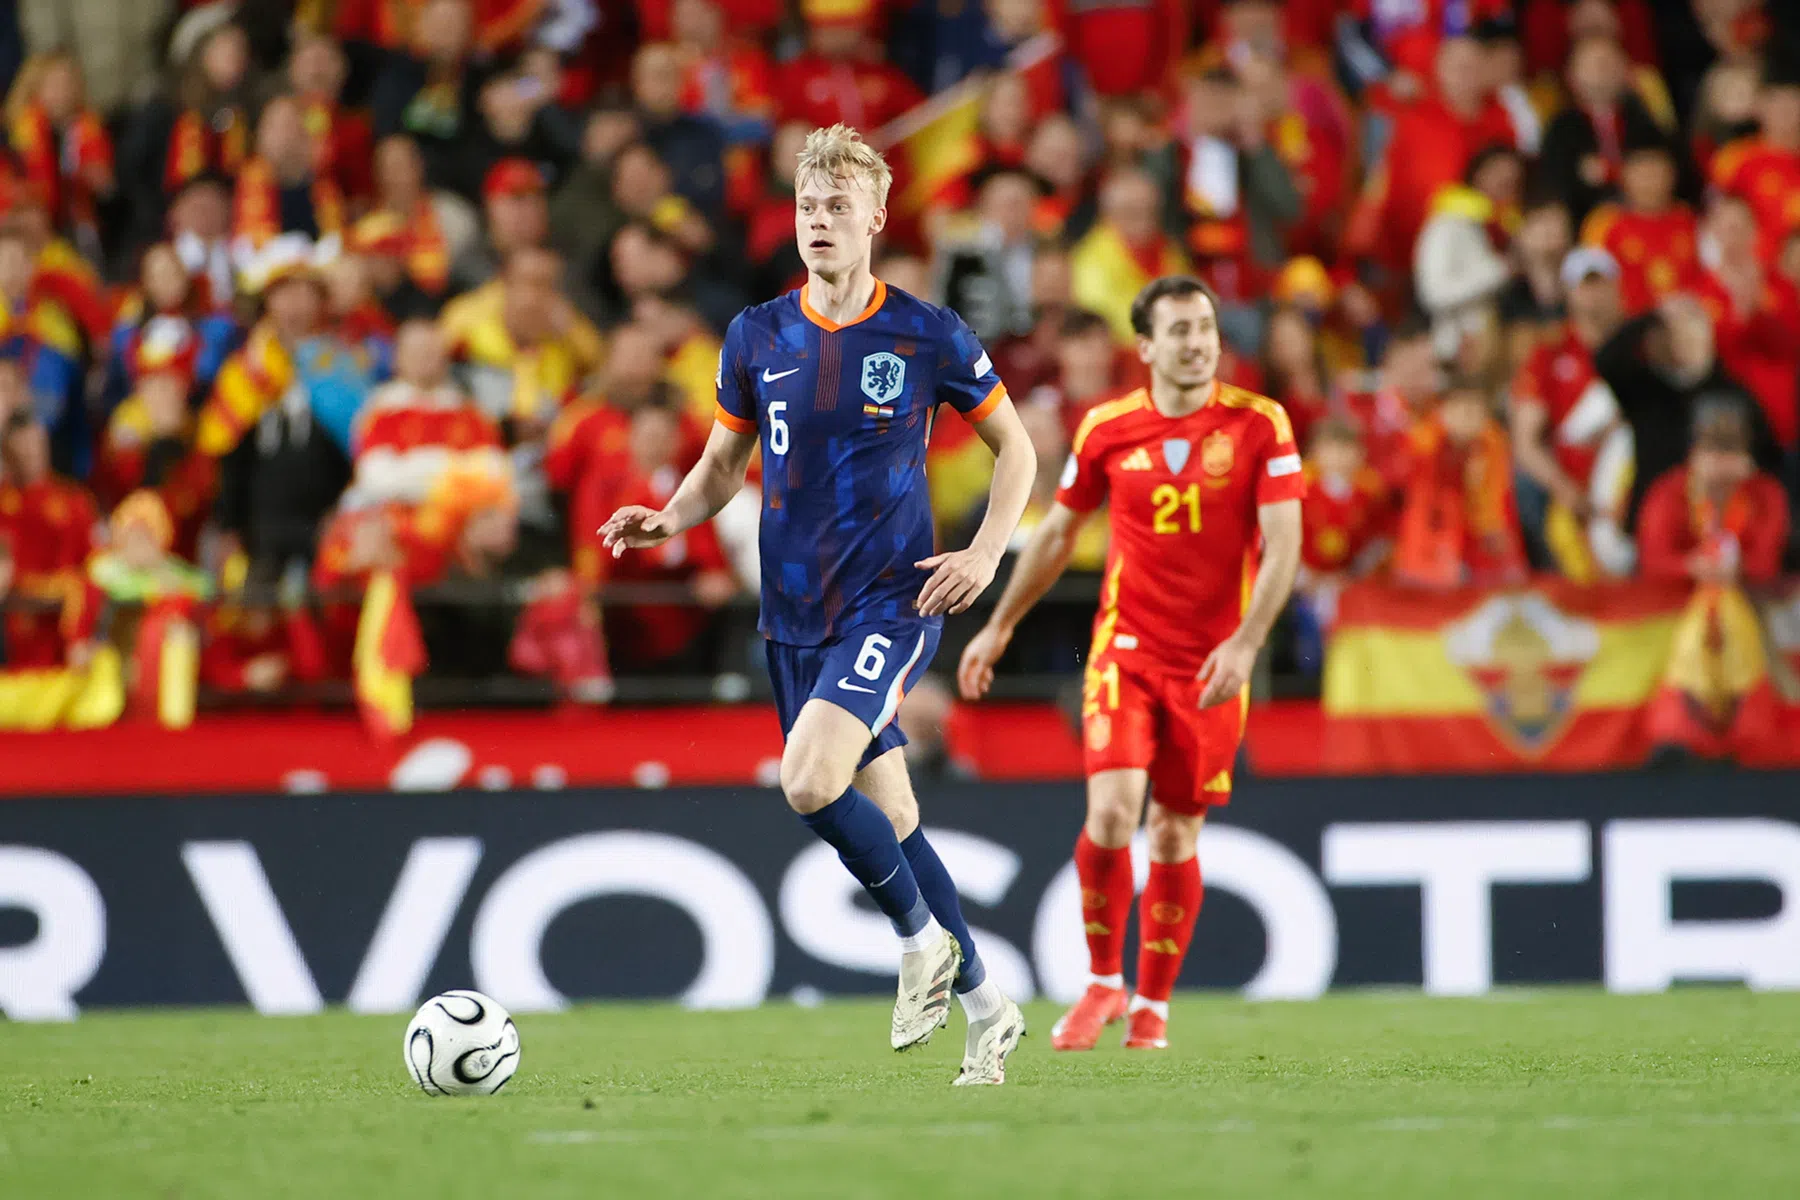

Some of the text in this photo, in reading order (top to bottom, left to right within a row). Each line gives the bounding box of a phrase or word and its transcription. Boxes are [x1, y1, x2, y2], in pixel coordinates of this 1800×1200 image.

[768, 401, 789, 455] 6
[1151, 483, 1202, 534] 21
[853, 633, 892, 681] 6
